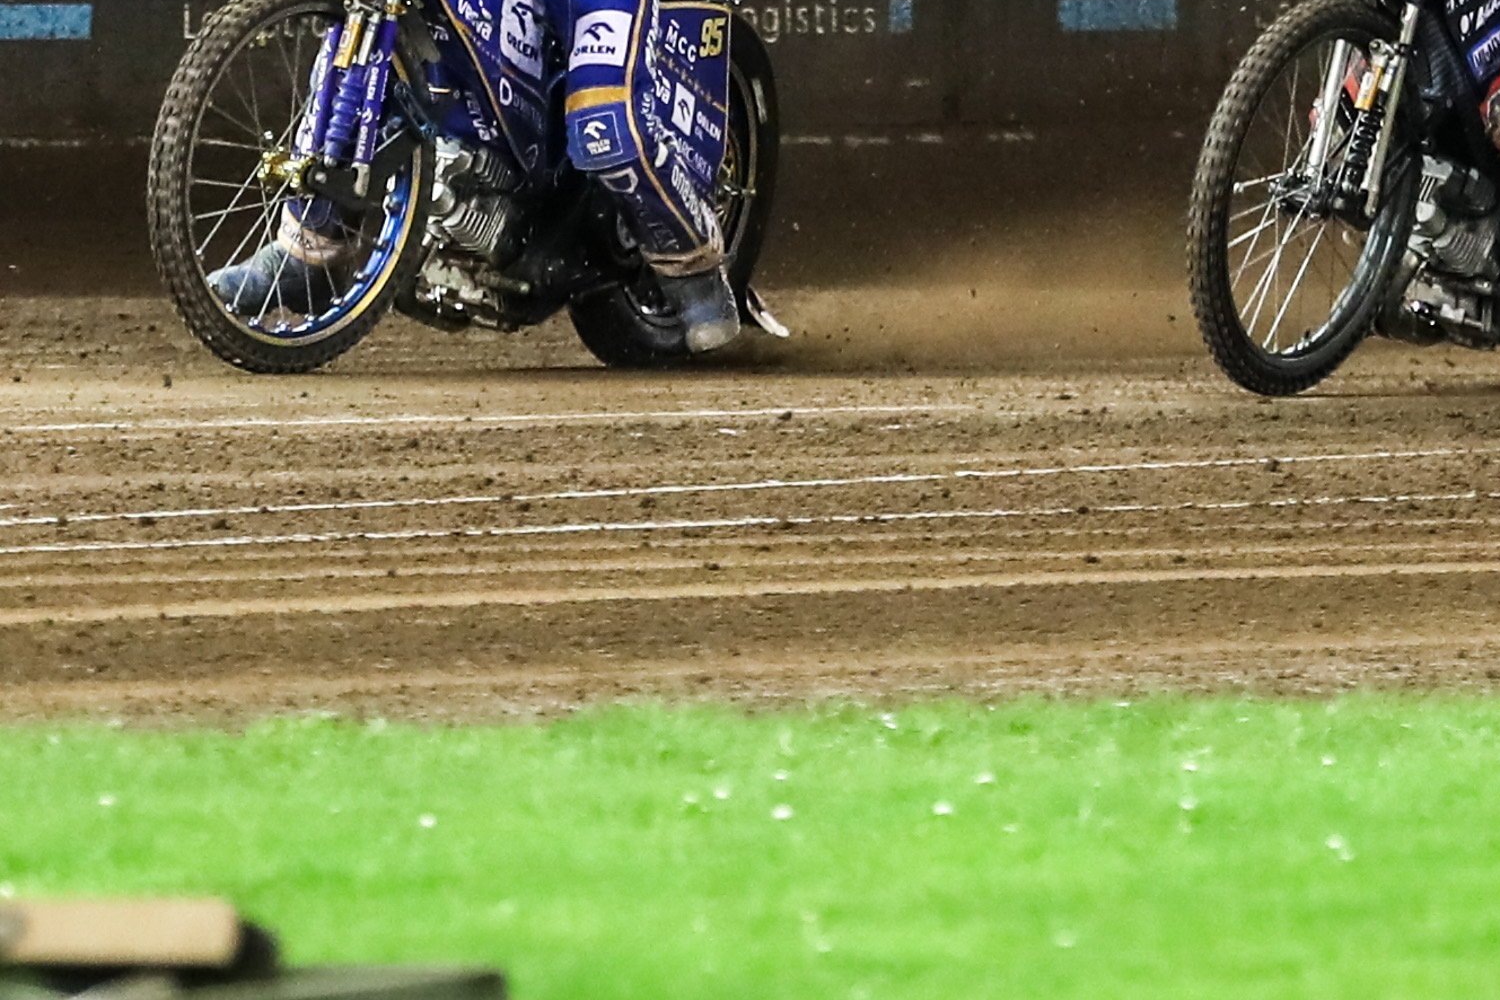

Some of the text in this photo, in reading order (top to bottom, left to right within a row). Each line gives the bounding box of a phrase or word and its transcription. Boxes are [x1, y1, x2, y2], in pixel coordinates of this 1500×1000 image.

[572, 44, 616, 57] ORLEN
[664, 19, 698, 64] MCG
[700, 18, 726, 58] 95
[696, 110, 722, 142] ORLEN
